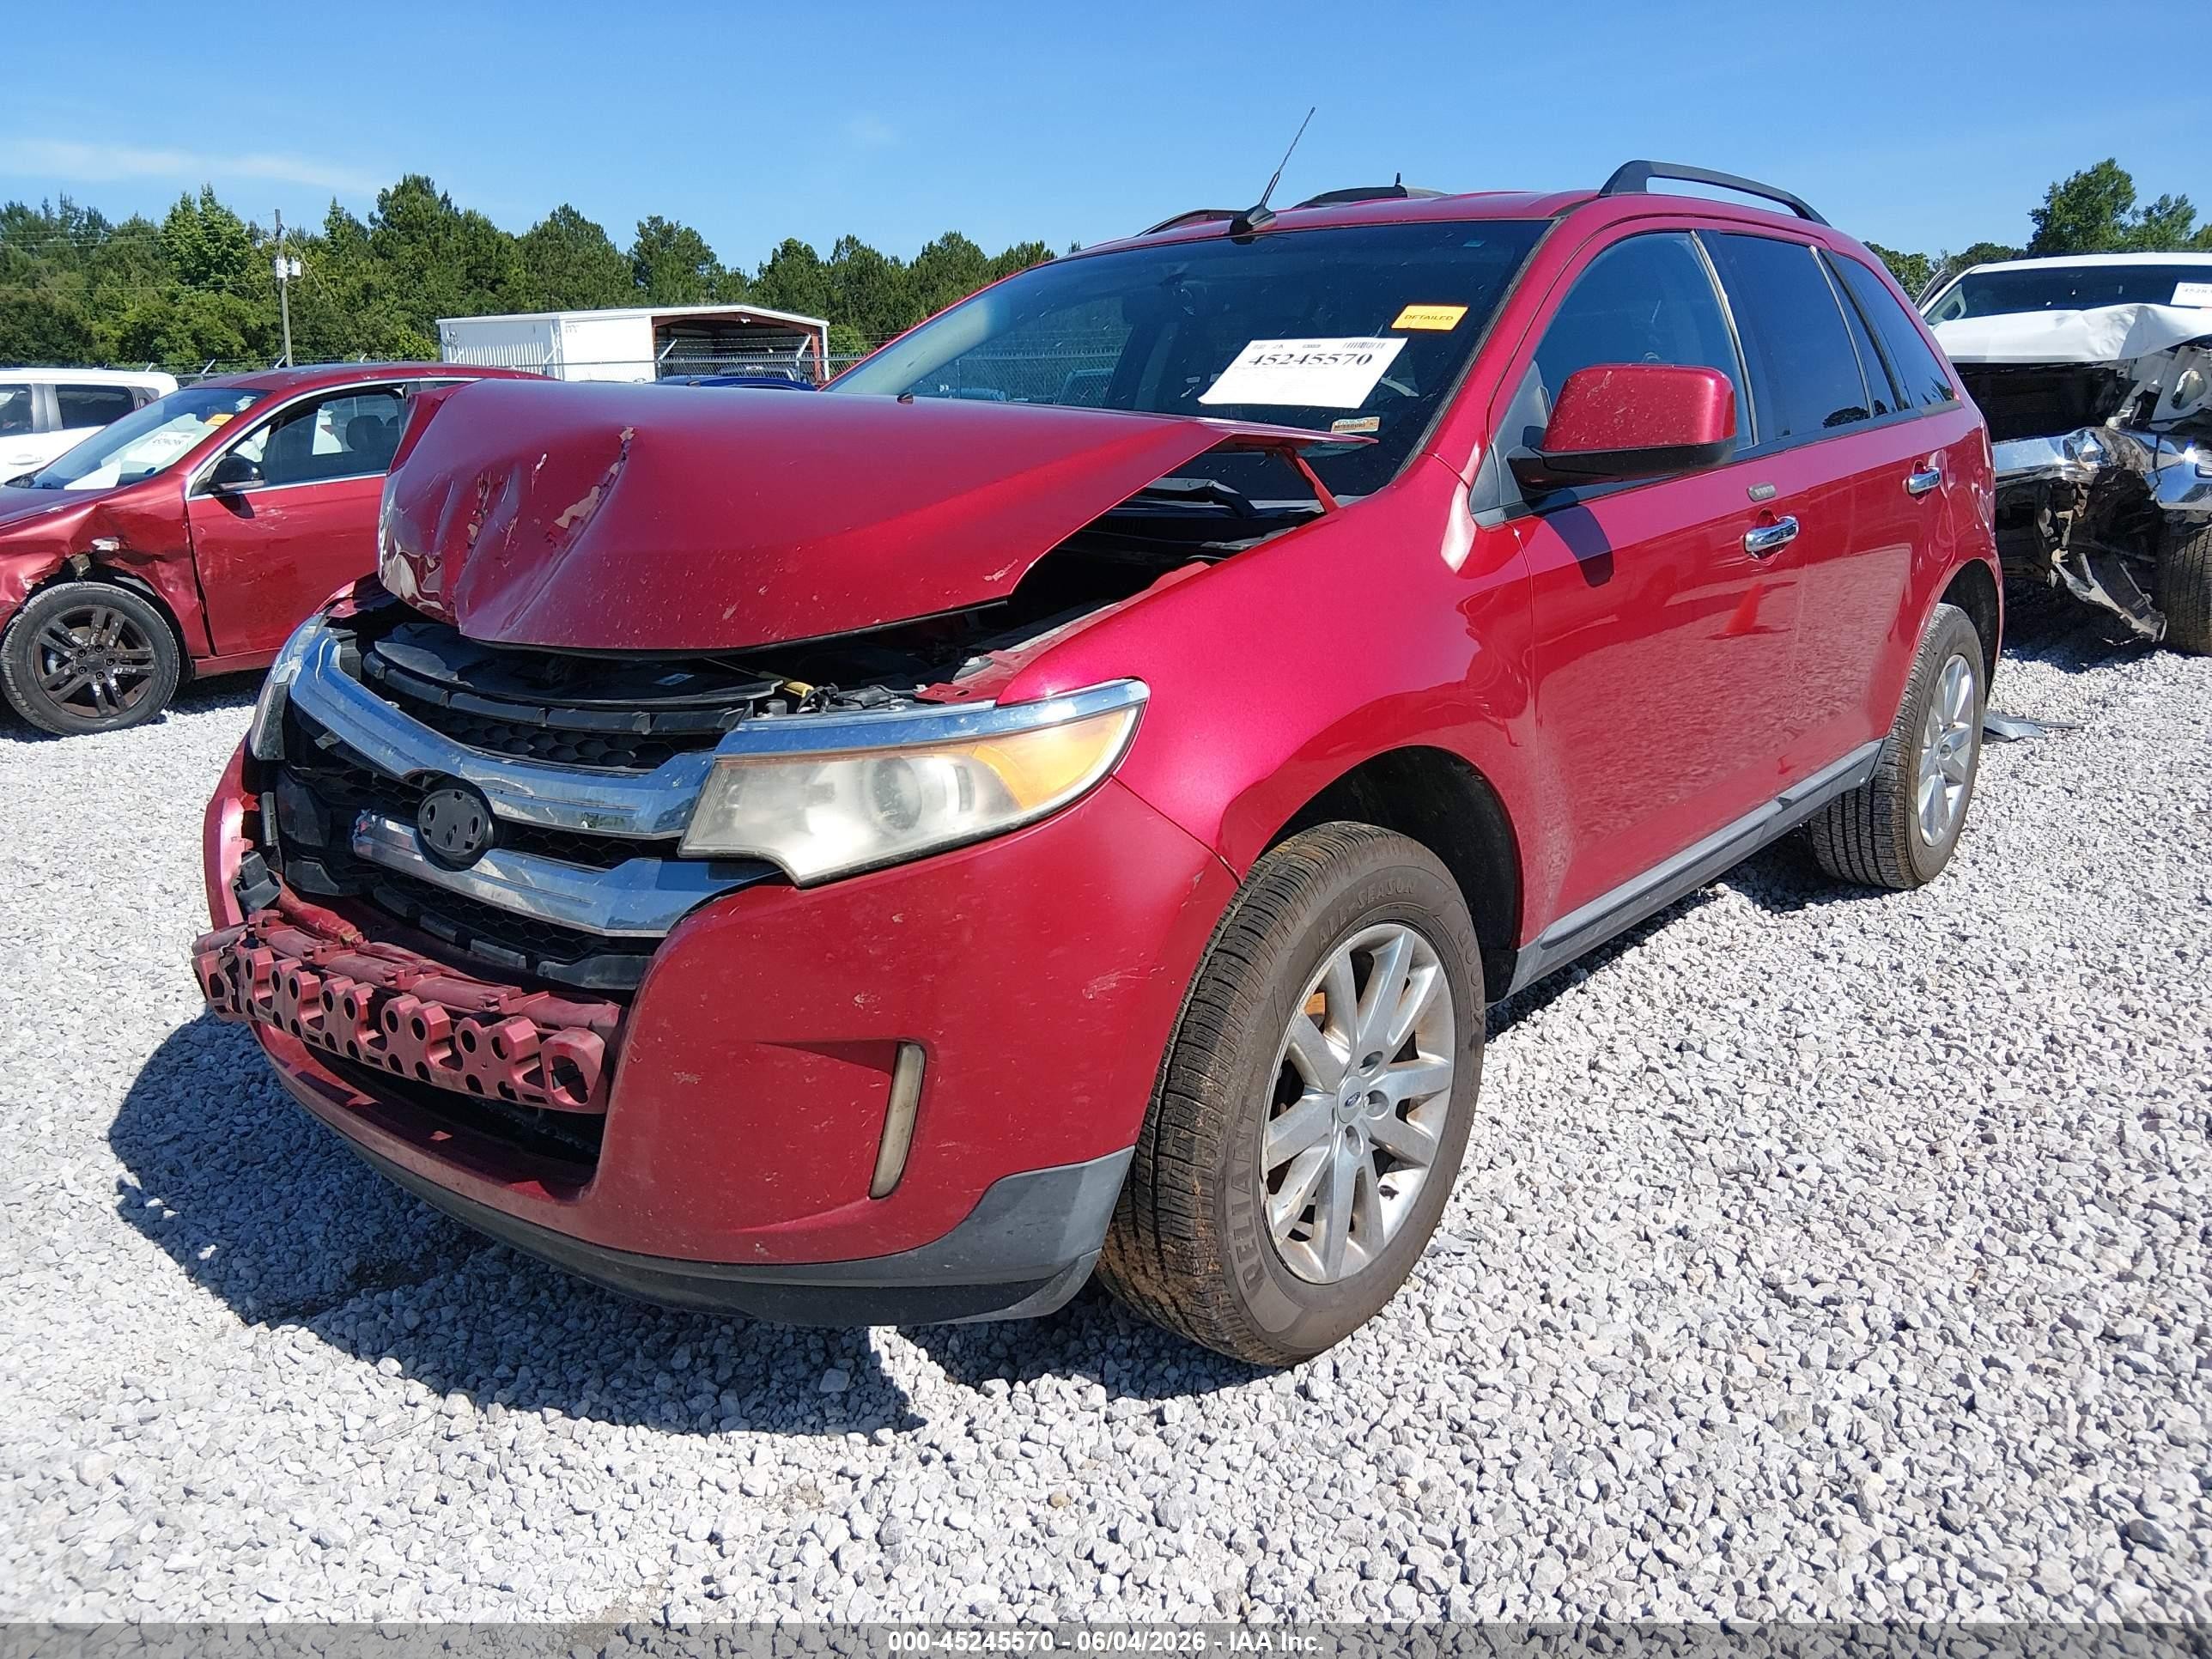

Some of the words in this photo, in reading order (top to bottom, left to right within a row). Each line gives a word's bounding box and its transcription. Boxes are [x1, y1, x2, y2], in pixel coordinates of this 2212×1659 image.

[1248, 353, 1373, 366] 45245570
[1318, 878, 1415, 949] ALL-SEASON
[1231, 1095, 1267, 1297] RELIANT
